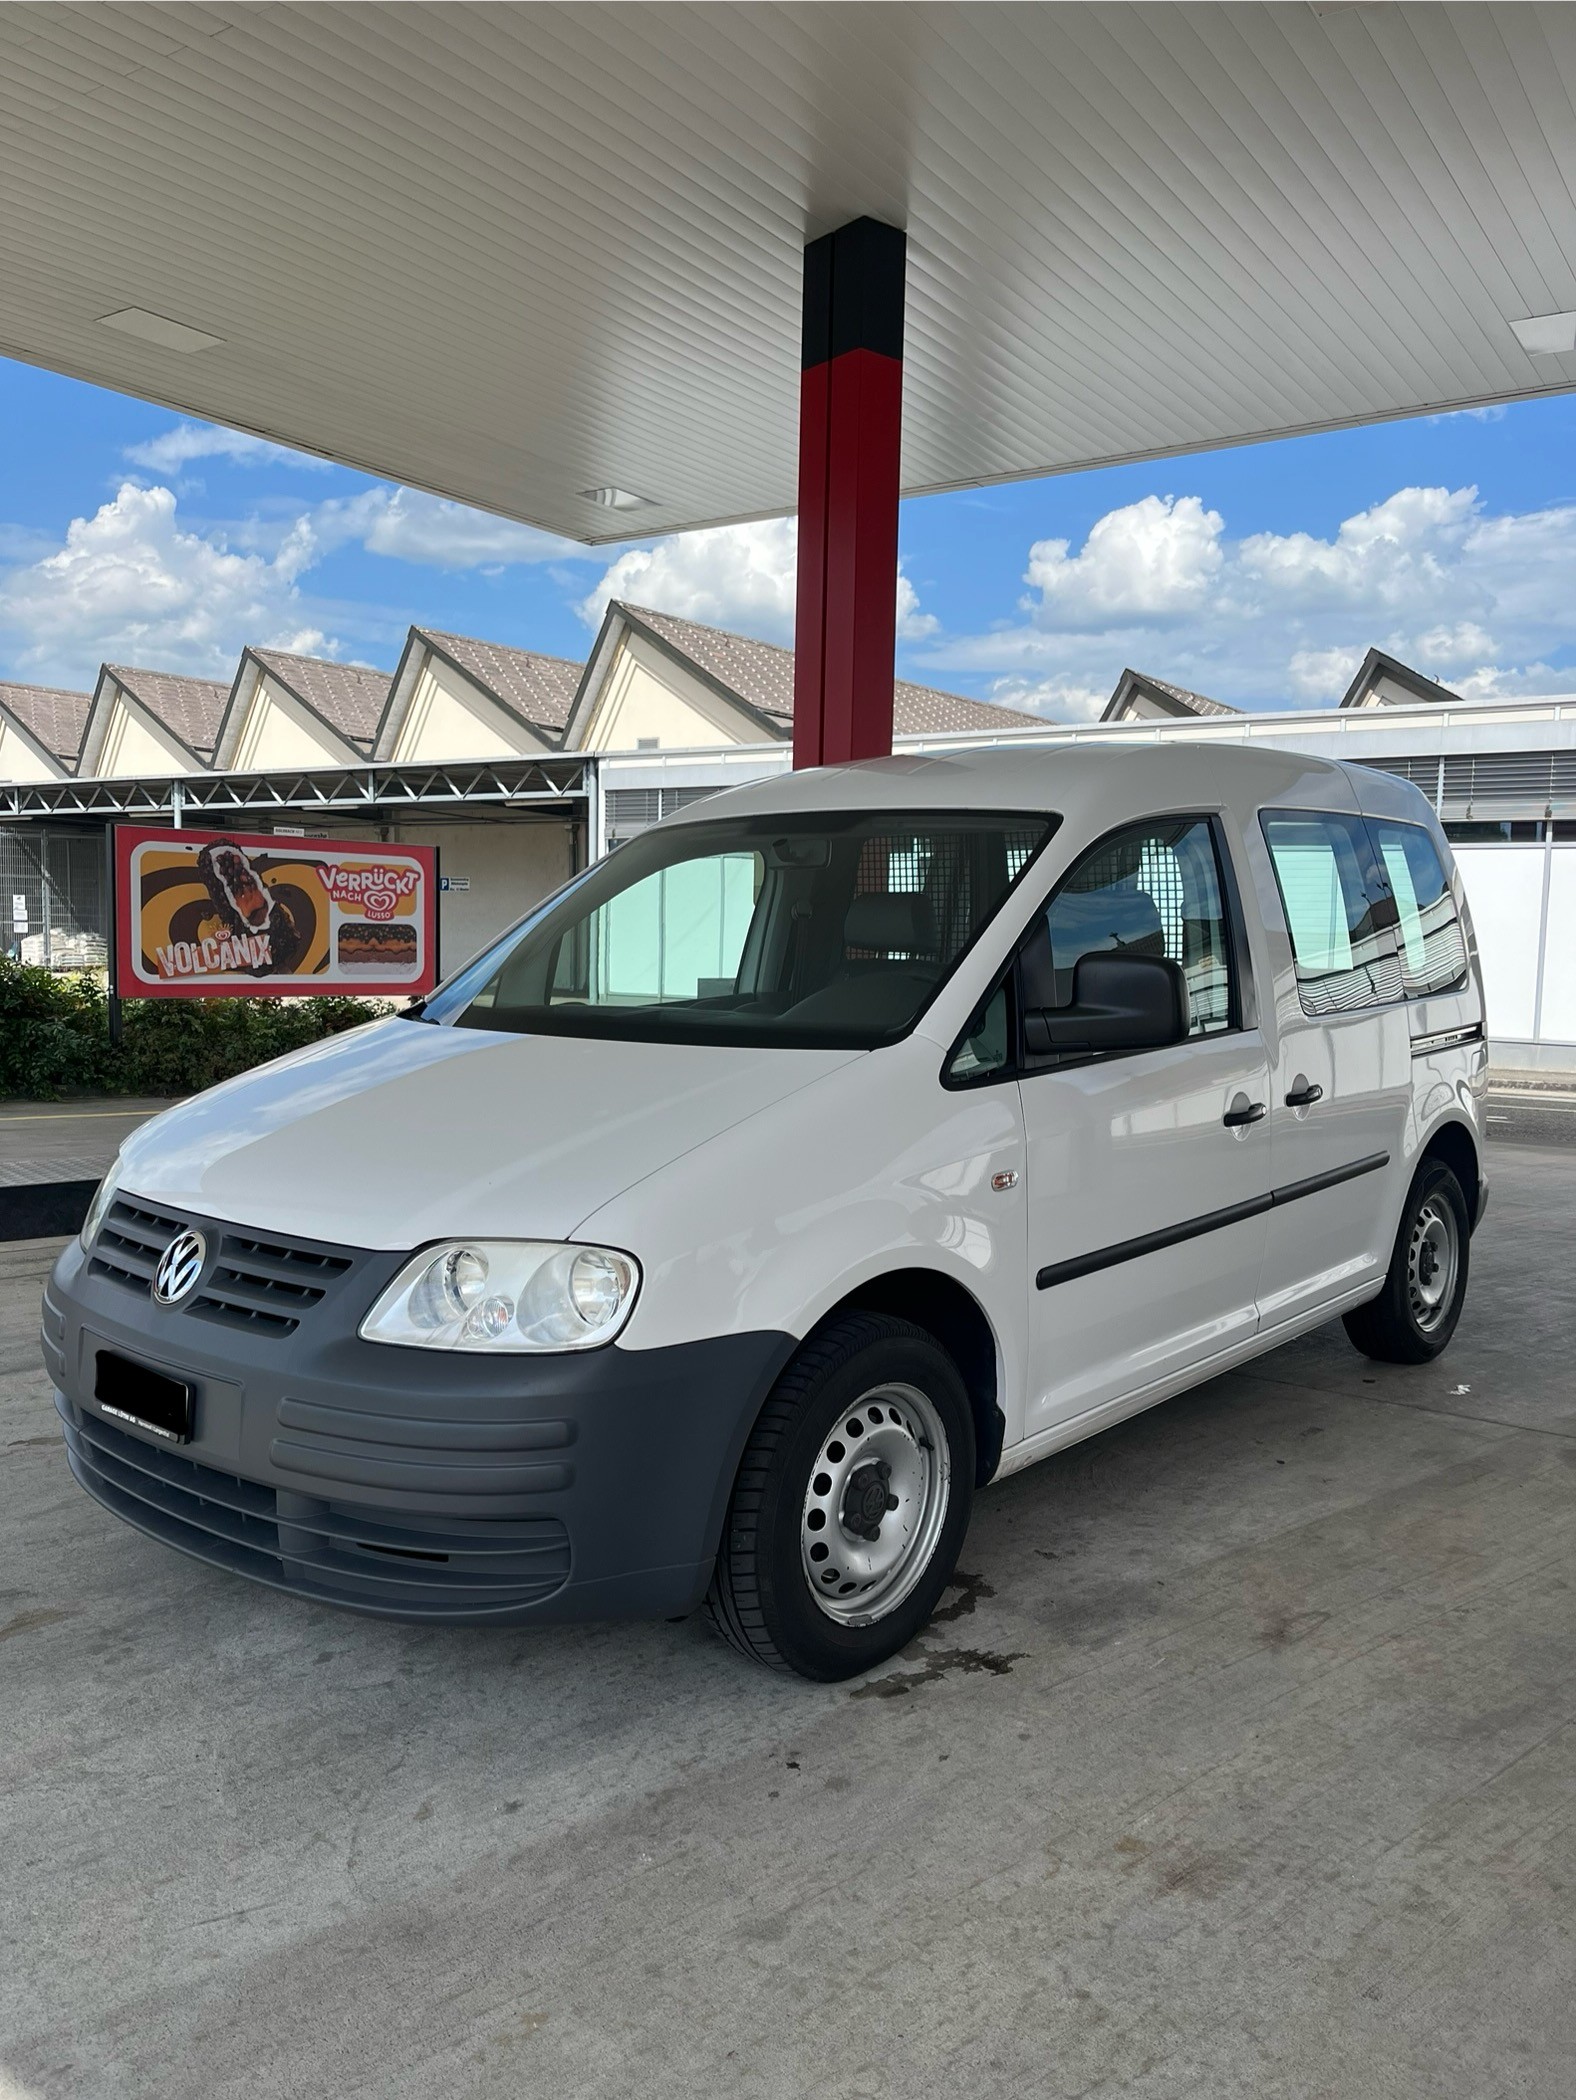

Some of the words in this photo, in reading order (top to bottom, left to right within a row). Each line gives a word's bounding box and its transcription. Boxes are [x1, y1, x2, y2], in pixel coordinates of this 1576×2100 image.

[441, 879, 448, 890] P
[332, 890, 362, 902] NACH
[367, 910, 391, 919] LUSSO
[156, 933, 273, 977] VOLCANIX
